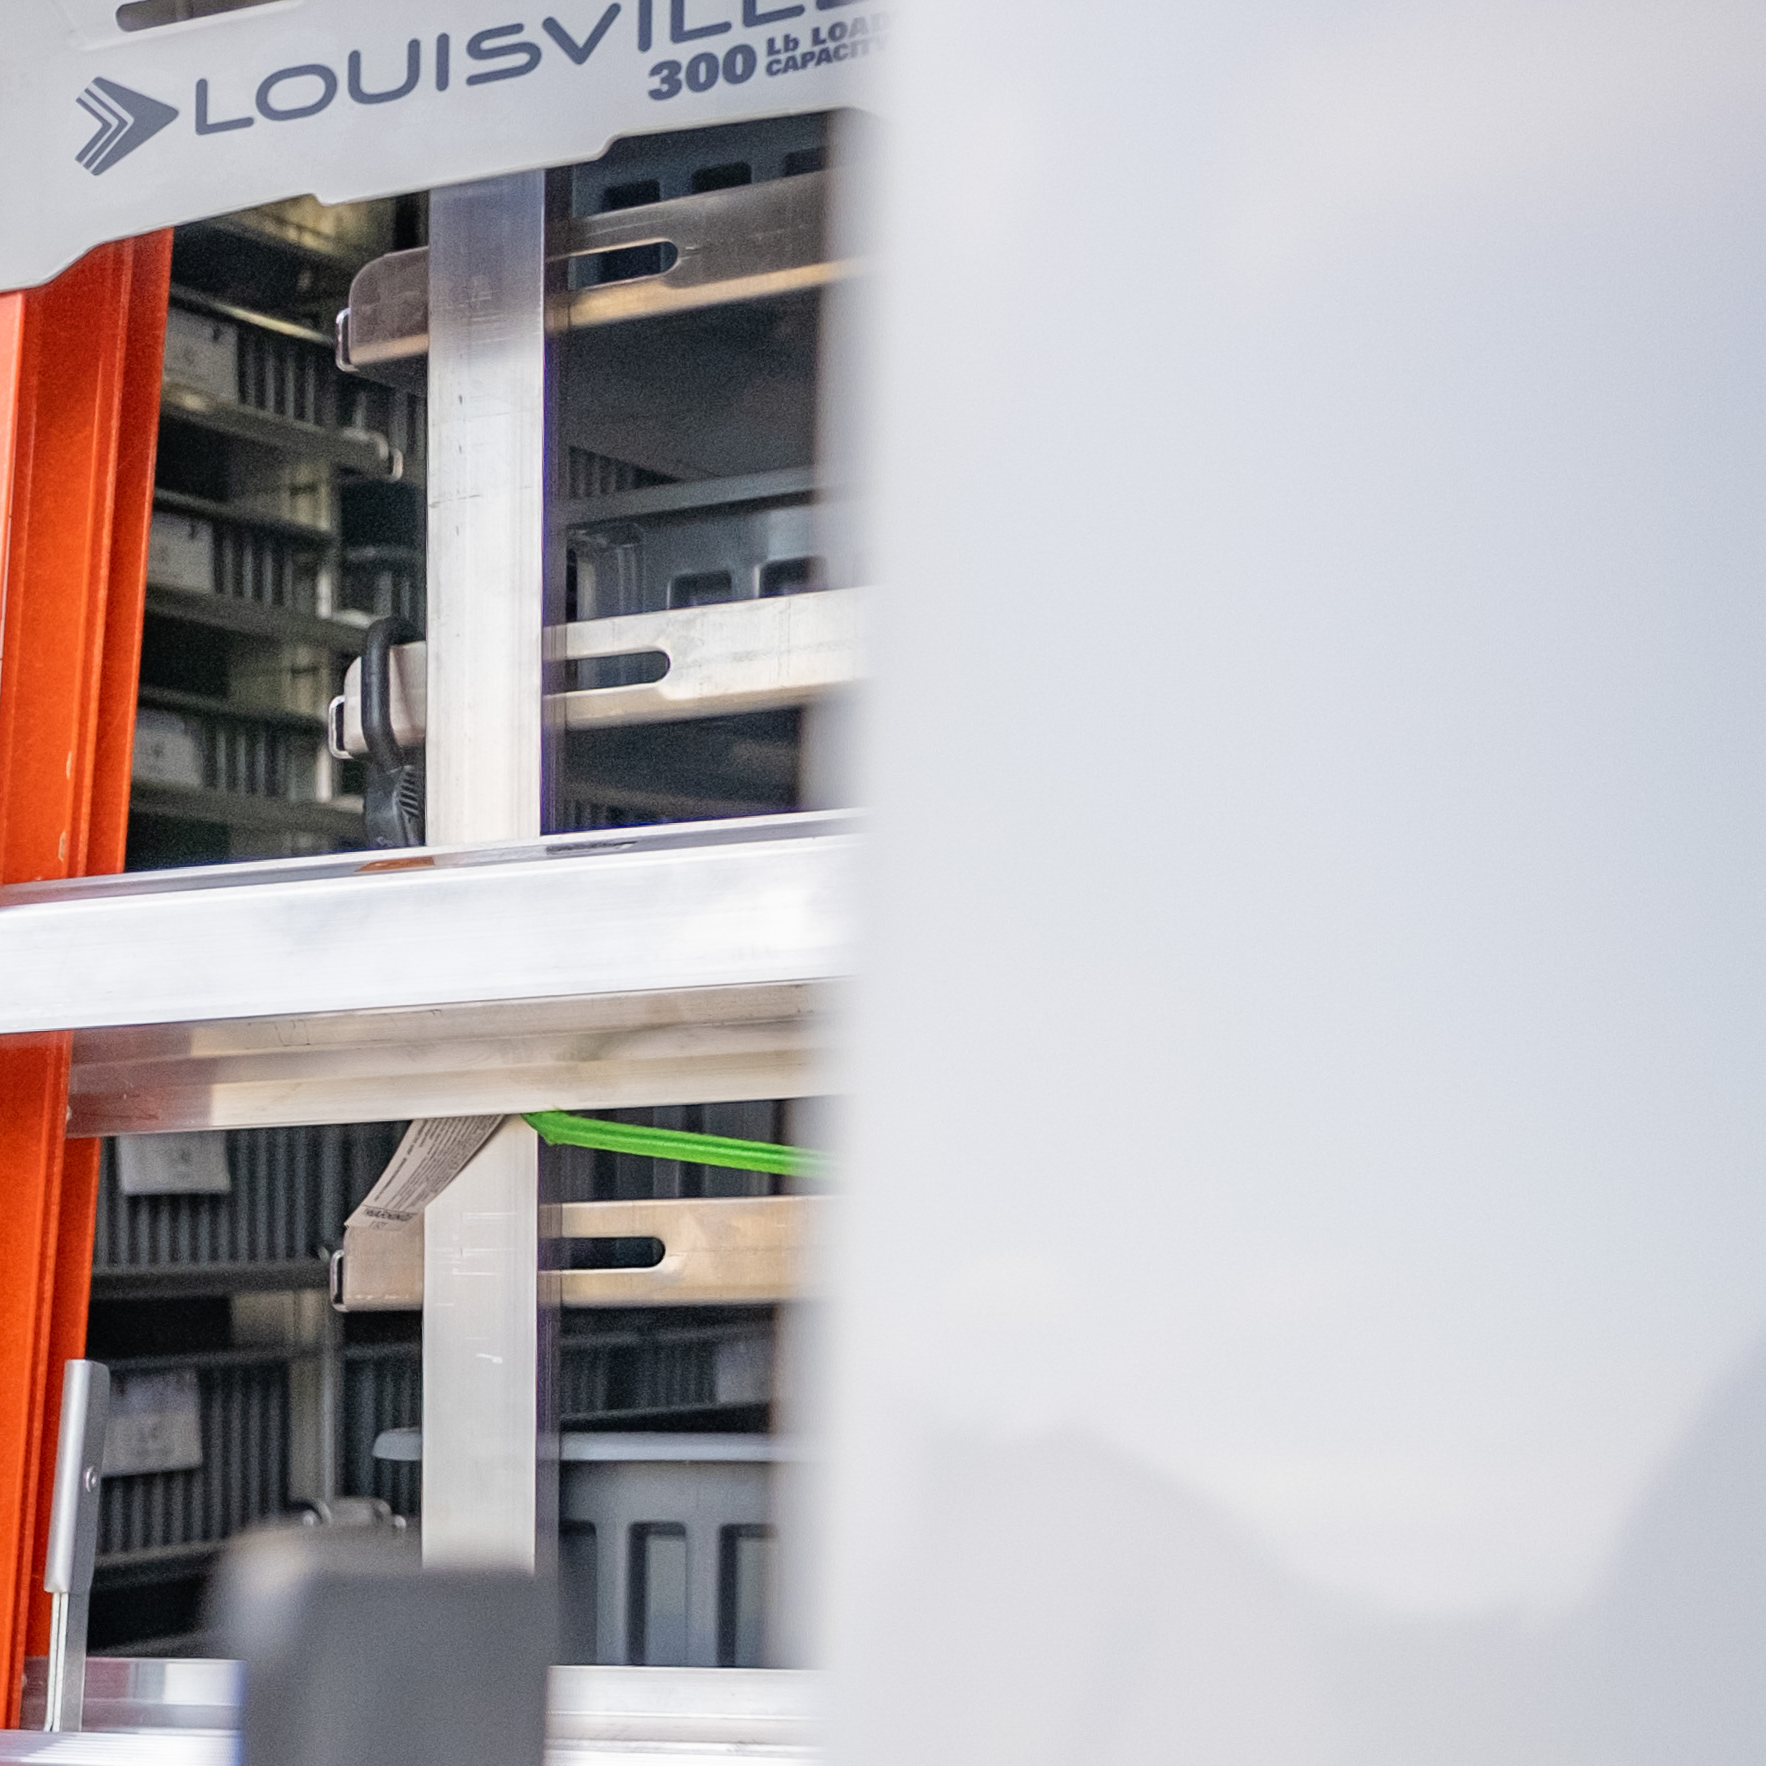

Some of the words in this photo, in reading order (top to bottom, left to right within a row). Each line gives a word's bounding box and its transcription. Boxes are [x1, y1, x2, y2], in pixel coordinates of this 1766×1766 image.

[194, 0, 864, 136] LOUISVILL
[648, 44, 757, 101] 300
[766, 34, 800, 56] Lb
